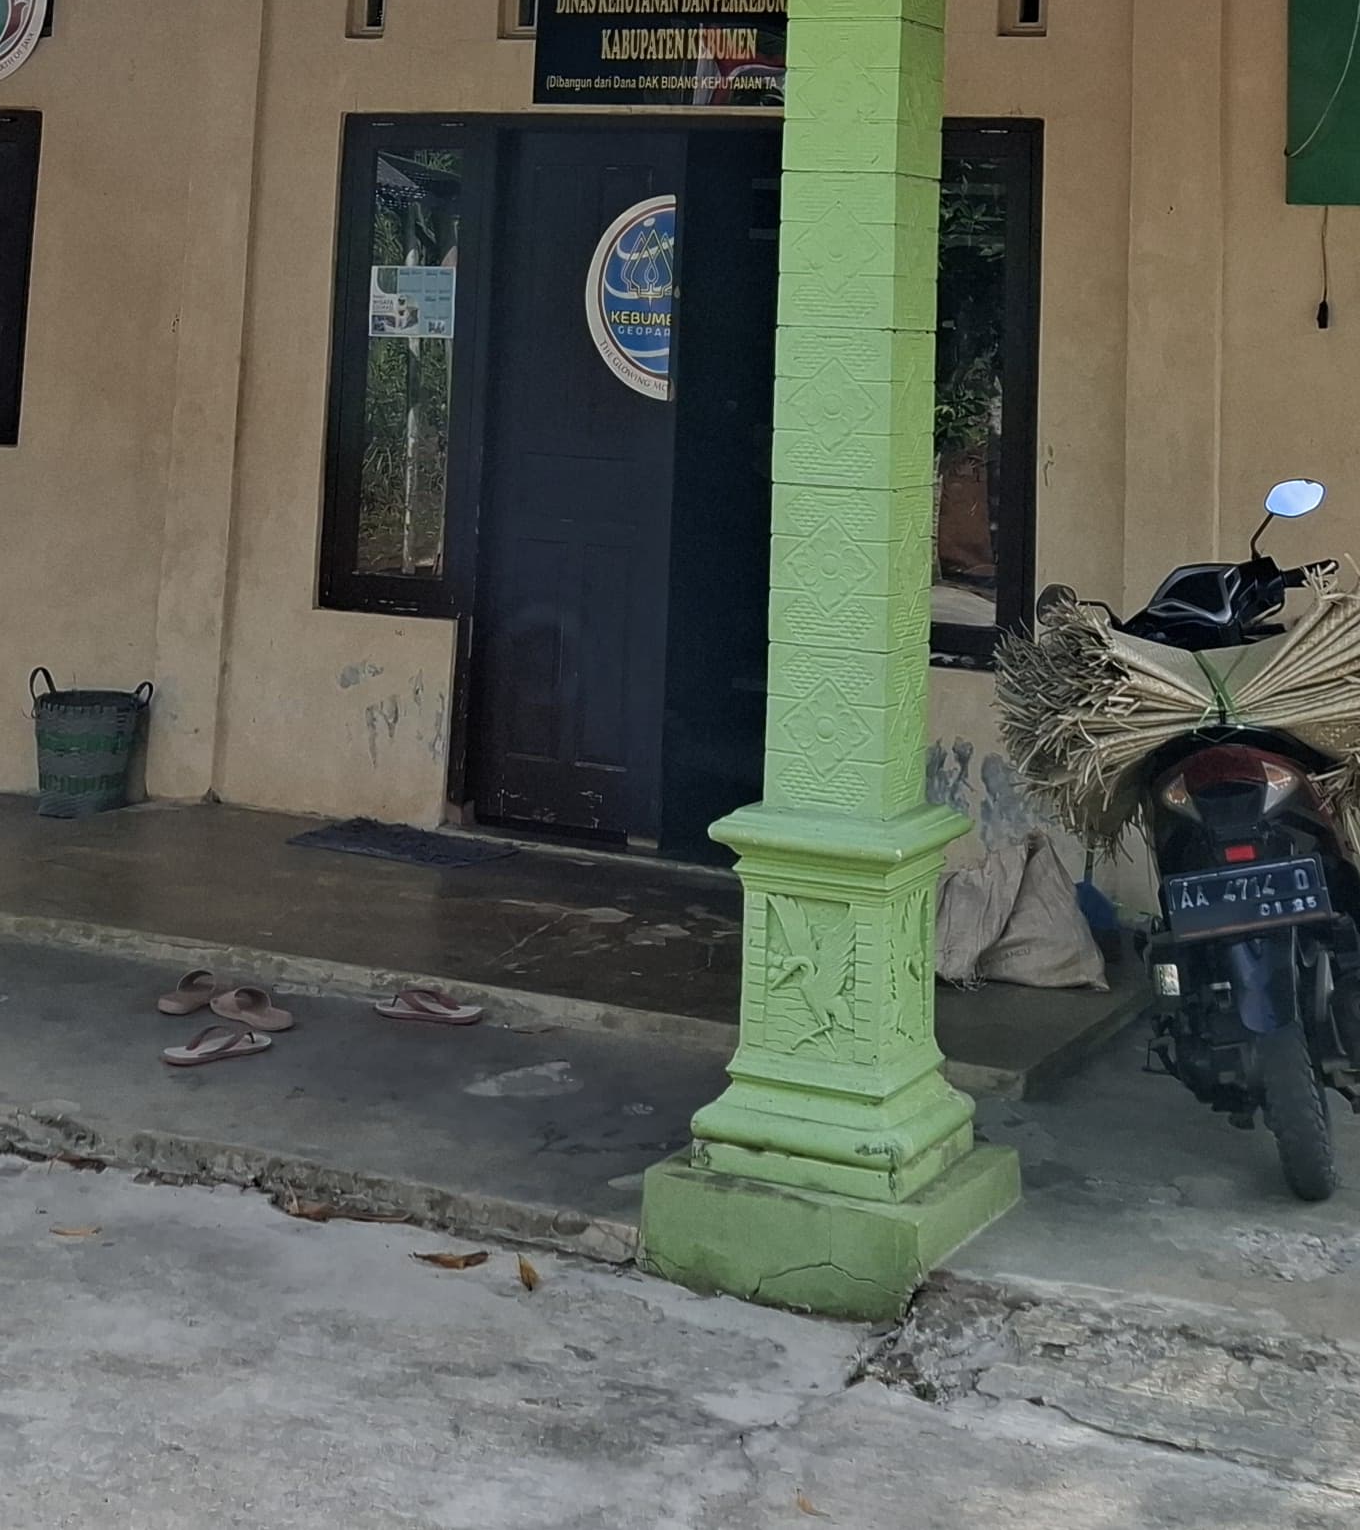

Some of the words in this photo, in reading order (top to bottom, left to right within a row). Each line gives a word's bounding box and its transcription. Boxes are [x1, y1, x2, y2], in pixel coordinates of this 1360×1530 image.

[601, 28, 686, 60] KABUPATEN
[687, 28, 758, 59] KEBUMEN
[546, 76, 592, 91] (Dibangun
[594, 77, 613, 89] dari
[613, 77, 637, 89] Dana
[638, 75, 659, 90] DAK
[661, 75, 699, 89] BIDANG
[700, 75, 760, 89] KEHUTANAN
[611, 311, 672, 326] KEBUME
[618, 326, 671, 337] GEOPAR
[1180, 882, 1210, 909] AA
